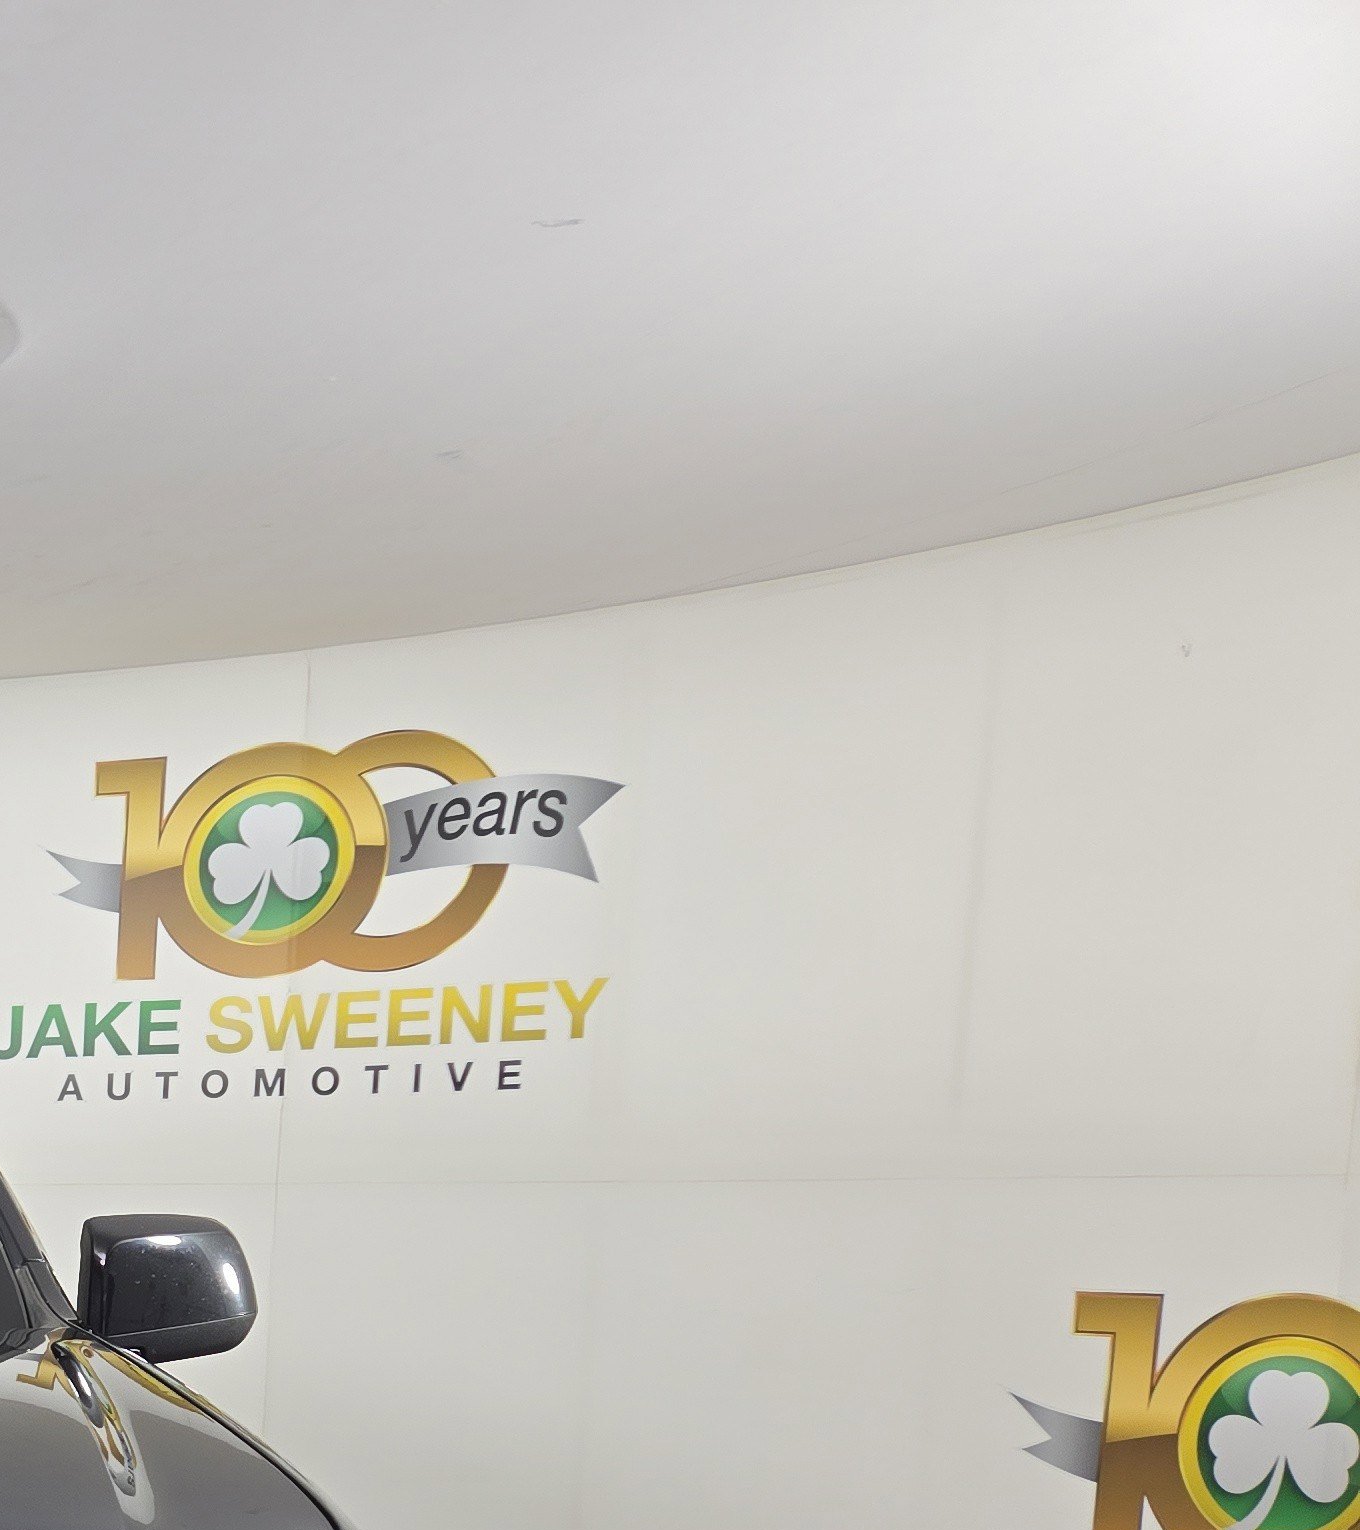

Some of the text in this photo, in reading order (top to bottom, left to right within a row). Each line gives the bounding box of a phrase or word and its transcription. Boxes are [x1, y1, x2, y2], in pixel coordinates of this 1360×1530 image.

[94, 728, 510, 981] 100
[399, 787, 569, 863] years
[204, 976, 611, 1054] SWEENEY
[56, 1058, 524, 1102] AUTOMOTIVE
